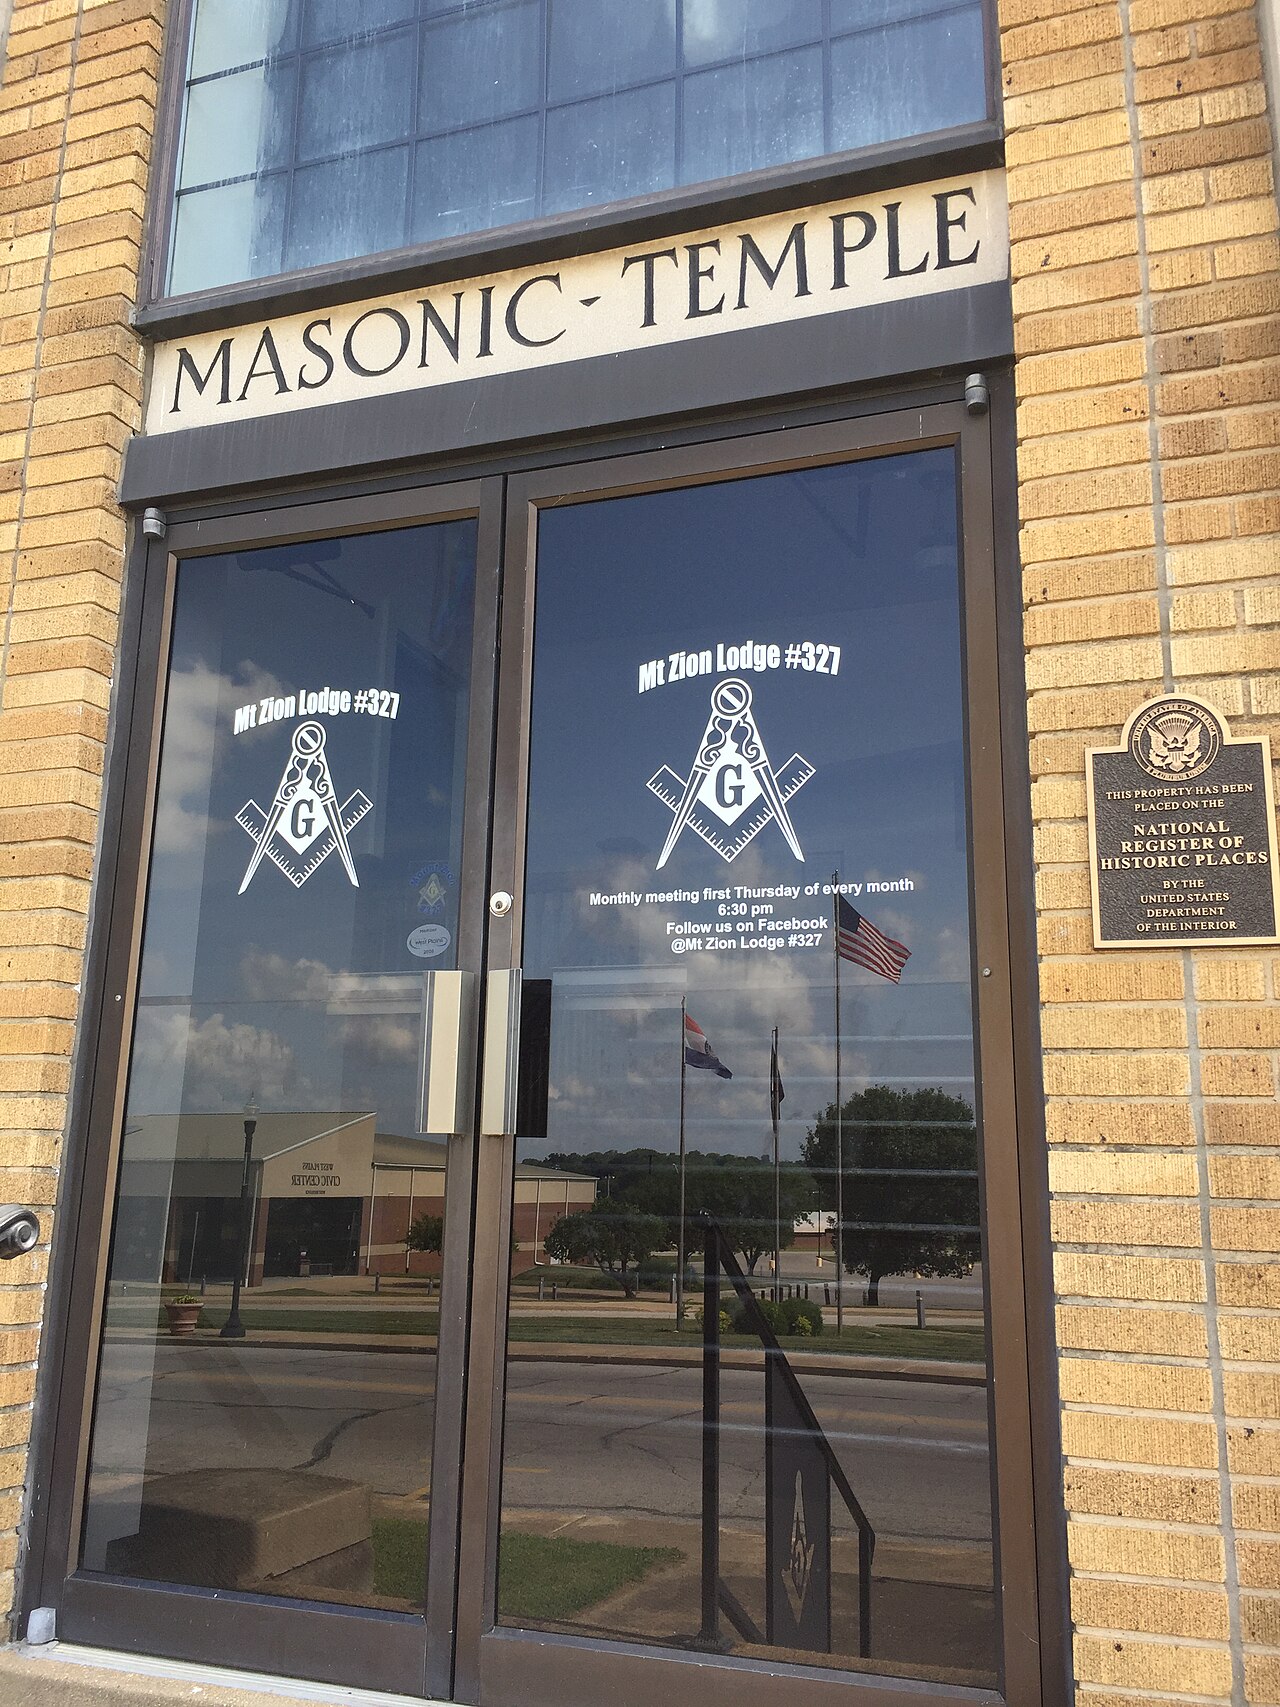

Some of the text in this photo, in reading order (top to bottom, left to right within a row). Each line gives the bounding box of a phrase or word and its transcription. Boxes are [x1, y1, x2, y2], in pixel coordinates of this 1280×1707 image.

[168, 186, 981, 415] MASONIC TEMPLE
[638, 640, 841, 694] Mt Zion Lodge #327
[233, 686, 400, 736] Mt Zion Lodge #327
[715, 763, 746, 809] G
[1106, 784, 1253, 800] THIS PROPERTY HAS BEEN
[1134, 799, 1225, 812] PLACED ON THE
[290, 798, 316, 839] G
[1133, 821, 1229, 836] NATIONAL
[1121, 836, 1244, 853] REGISTER OF
[1101, 852, 1268, 870] HISTORIC PLACES
[589, 877, 915, 908] Monthly meeting first Thursday of every month
[1163, 879, 1204, 889] BY THE
[1140, 893, 1230, 904] UNITED STATES
[717, 903, 774, 918] 6:30 pm
[1147, 907, 1225, 918] DEPARTMENT
[666, 915, 829, 935] Follow us on Facebook
[1137, 921, 1237, 932] OF THE INTERIOR
[670, 932, 822, 955] @Mt Zion Lodge #327
